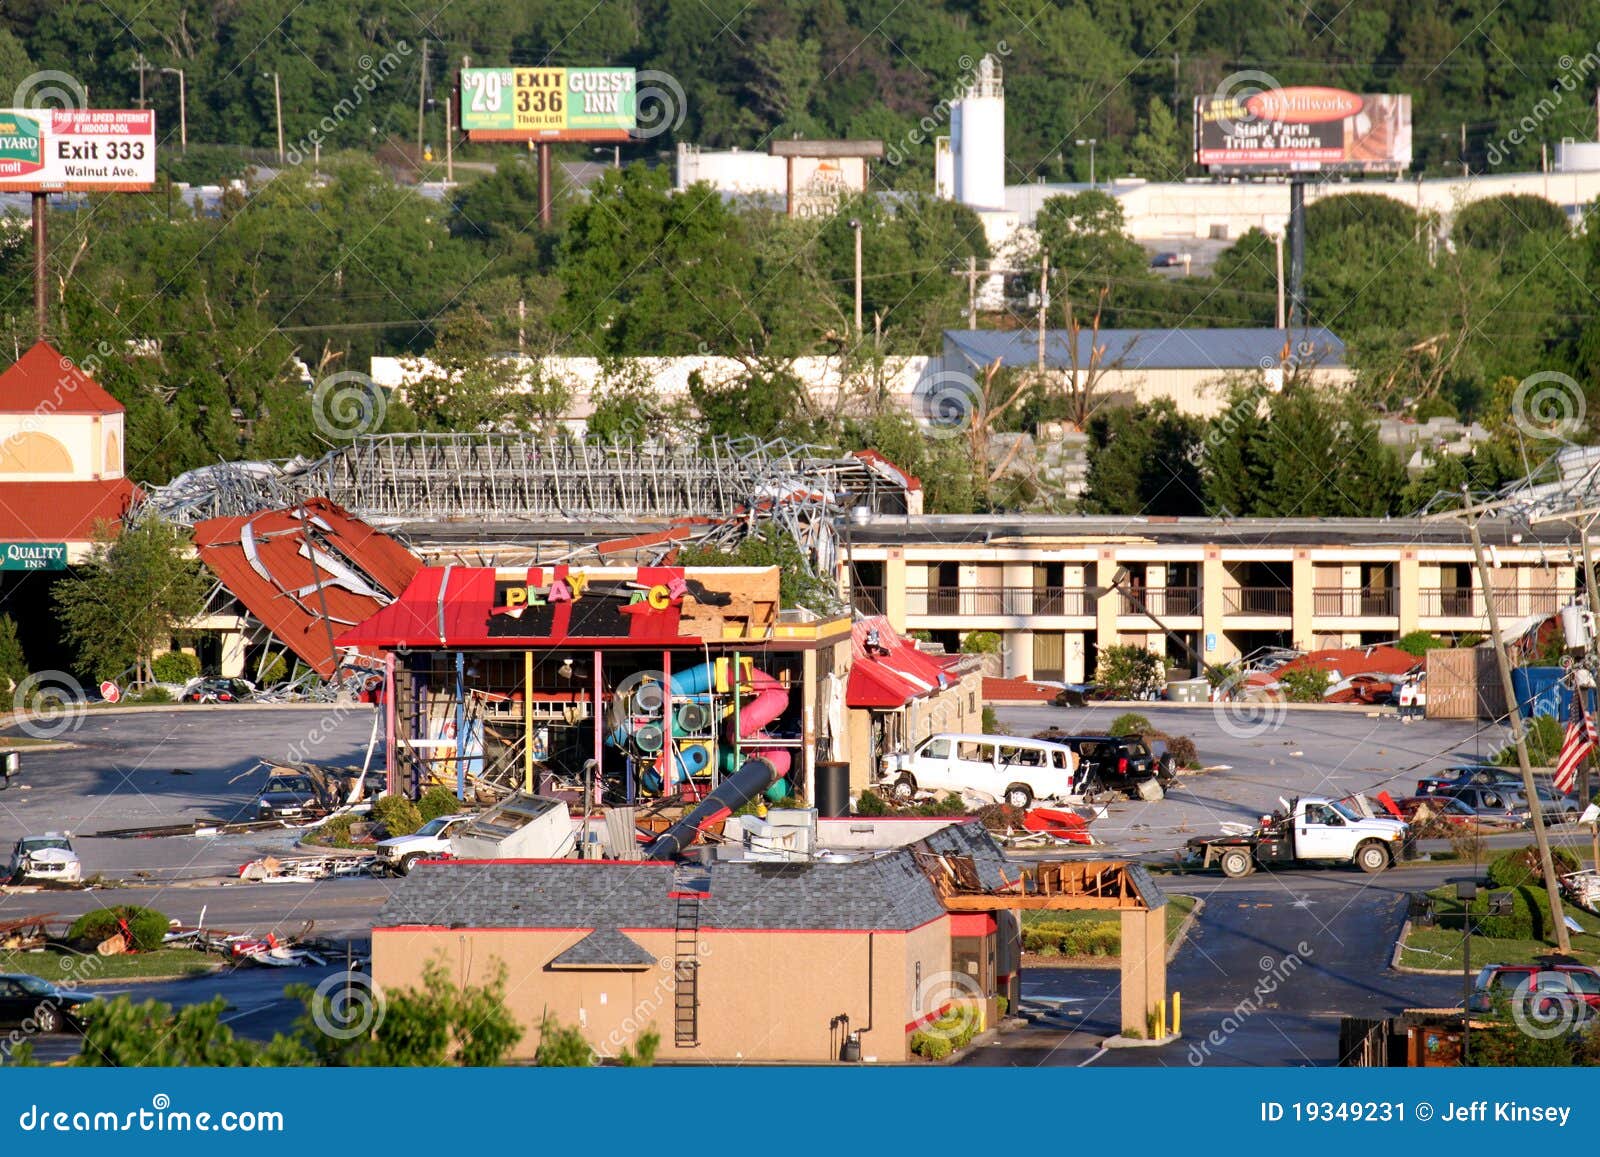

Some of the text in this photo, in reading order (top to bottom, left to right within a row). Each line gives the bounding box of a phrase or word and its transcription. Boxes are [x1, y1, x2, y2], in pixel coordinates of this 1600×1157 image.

[516, 73, 564, 87] EXIT
[569, 73, 633, 93] GUEST
[517, 90, 563, 112] 336
[584, 92, 619, 113] INN
[1281, 96, 1353, 111] Millworks
[517, 115, 542, 124] Then
[110, 123, 129, 133] POOL
[1234, 122, 1310, 137] Stair Parts
[1224, 135, 1321, 149] Trim & Doors
[58, 141, 145, 160] Exit 333
[64, 166, 138, 177] Walnut Ave.
[24, 560, 47, 568] INN
[506, 571, 587, 608] PLAY
